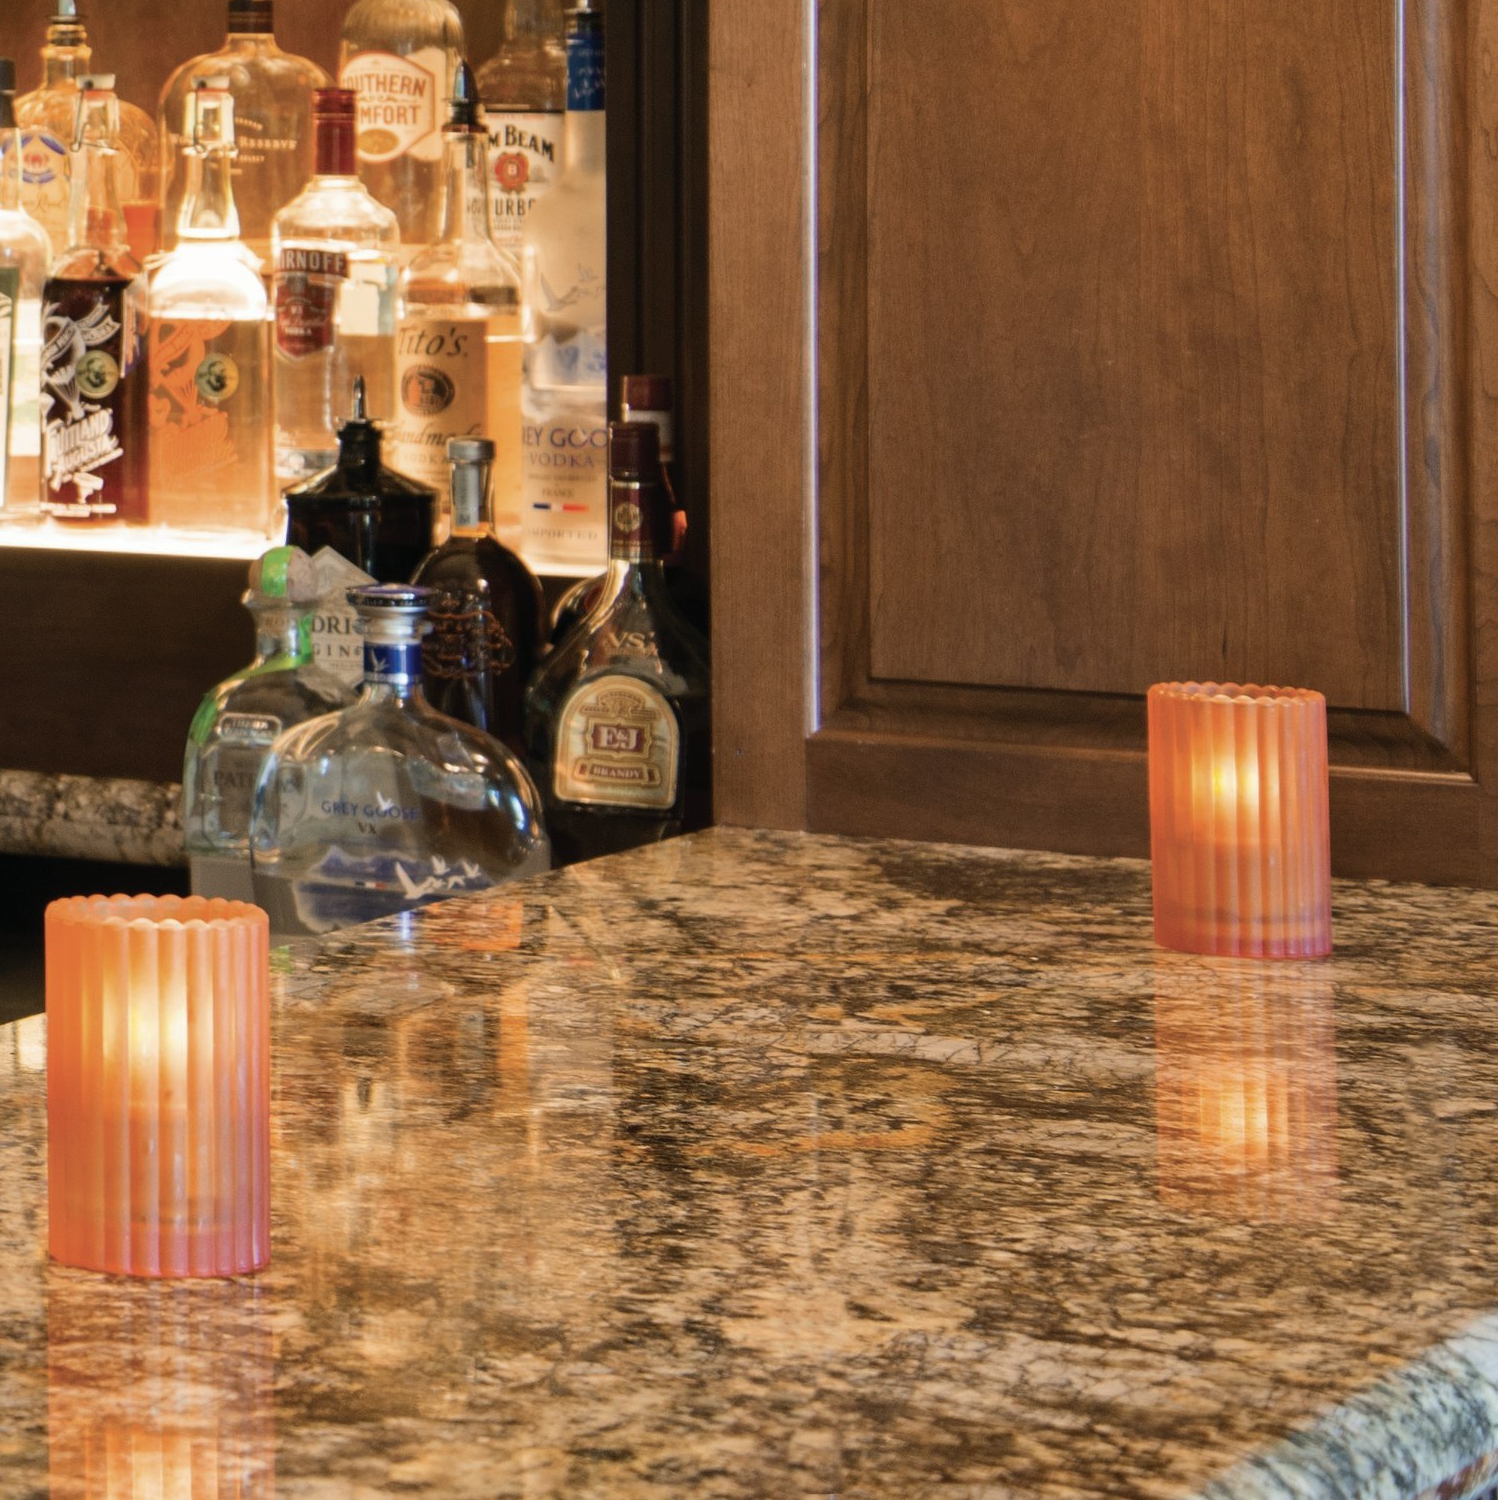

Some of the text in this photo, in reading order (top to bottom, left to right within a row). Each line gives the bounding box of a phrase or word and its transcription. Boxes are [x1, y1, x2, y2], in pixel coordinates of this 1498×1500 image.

[346, 73, 427, 97] OUTHERN
[360, 104, 420, 125] MFORT
[505, 125, 555, 163] BEAM
[281, 250, 344, 272] IRNOFF
[398, 325, 467, 357] Tito's
[550, 427, 607, 448] GOO
[530, 452, 595, 468] VODKA
[598, 726, 639, 750] E&J
[593, 763, 642, 780] BRANDY
[321, 800, 358, 817] GREY
[357, 821, 377, 835] VX
